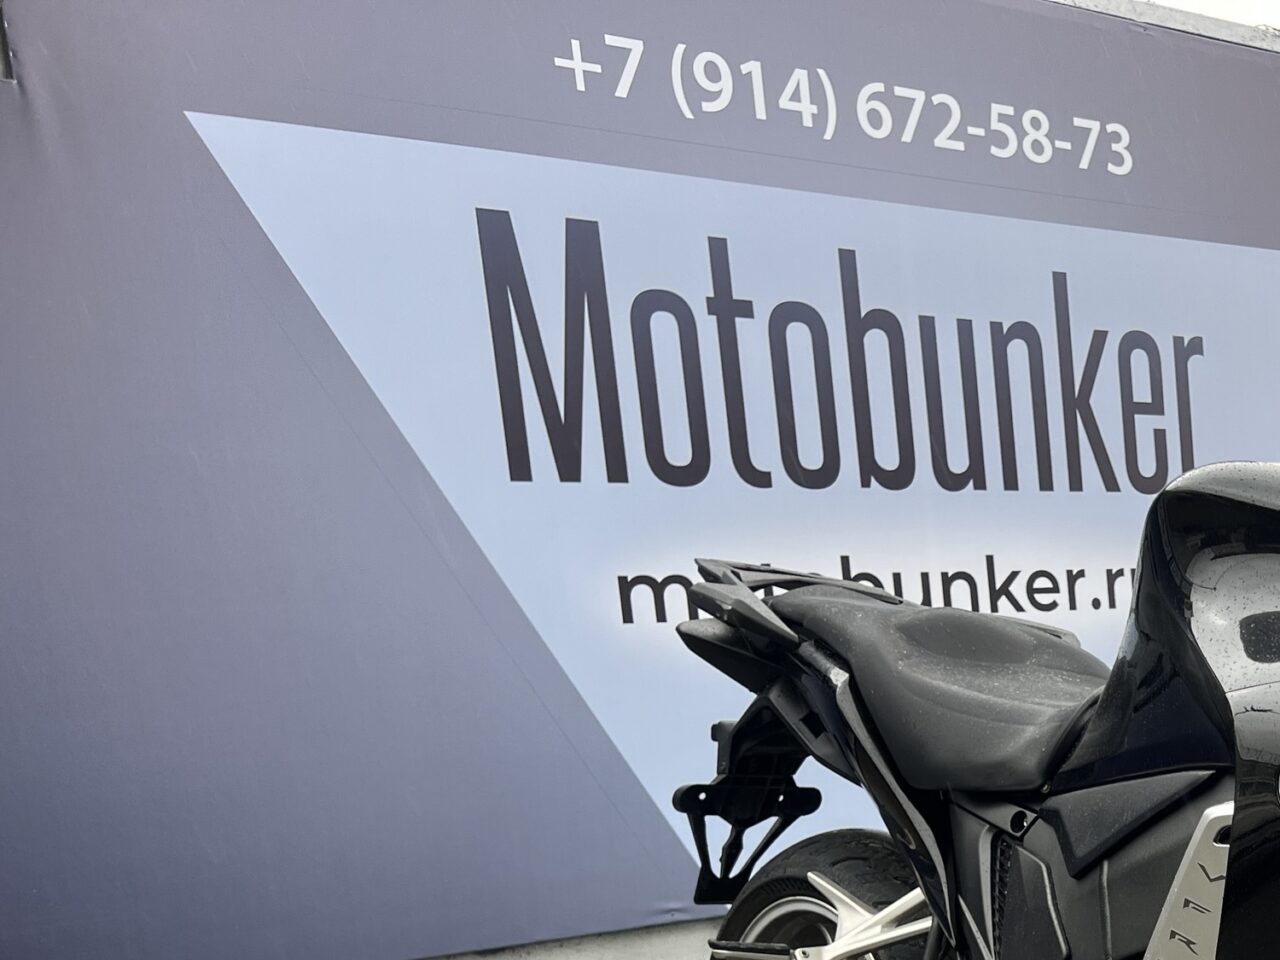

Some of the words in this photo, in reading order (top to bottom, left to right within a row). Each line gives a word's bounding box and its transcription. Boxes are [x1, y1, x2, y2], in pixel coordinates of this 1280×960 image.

[554, 34, 644, 98] +7
[671, 43, 837, 140] (914)
[856, 82, 1133, 175] 672-58-73
[475, 207, 1204, 494] Motobunker
